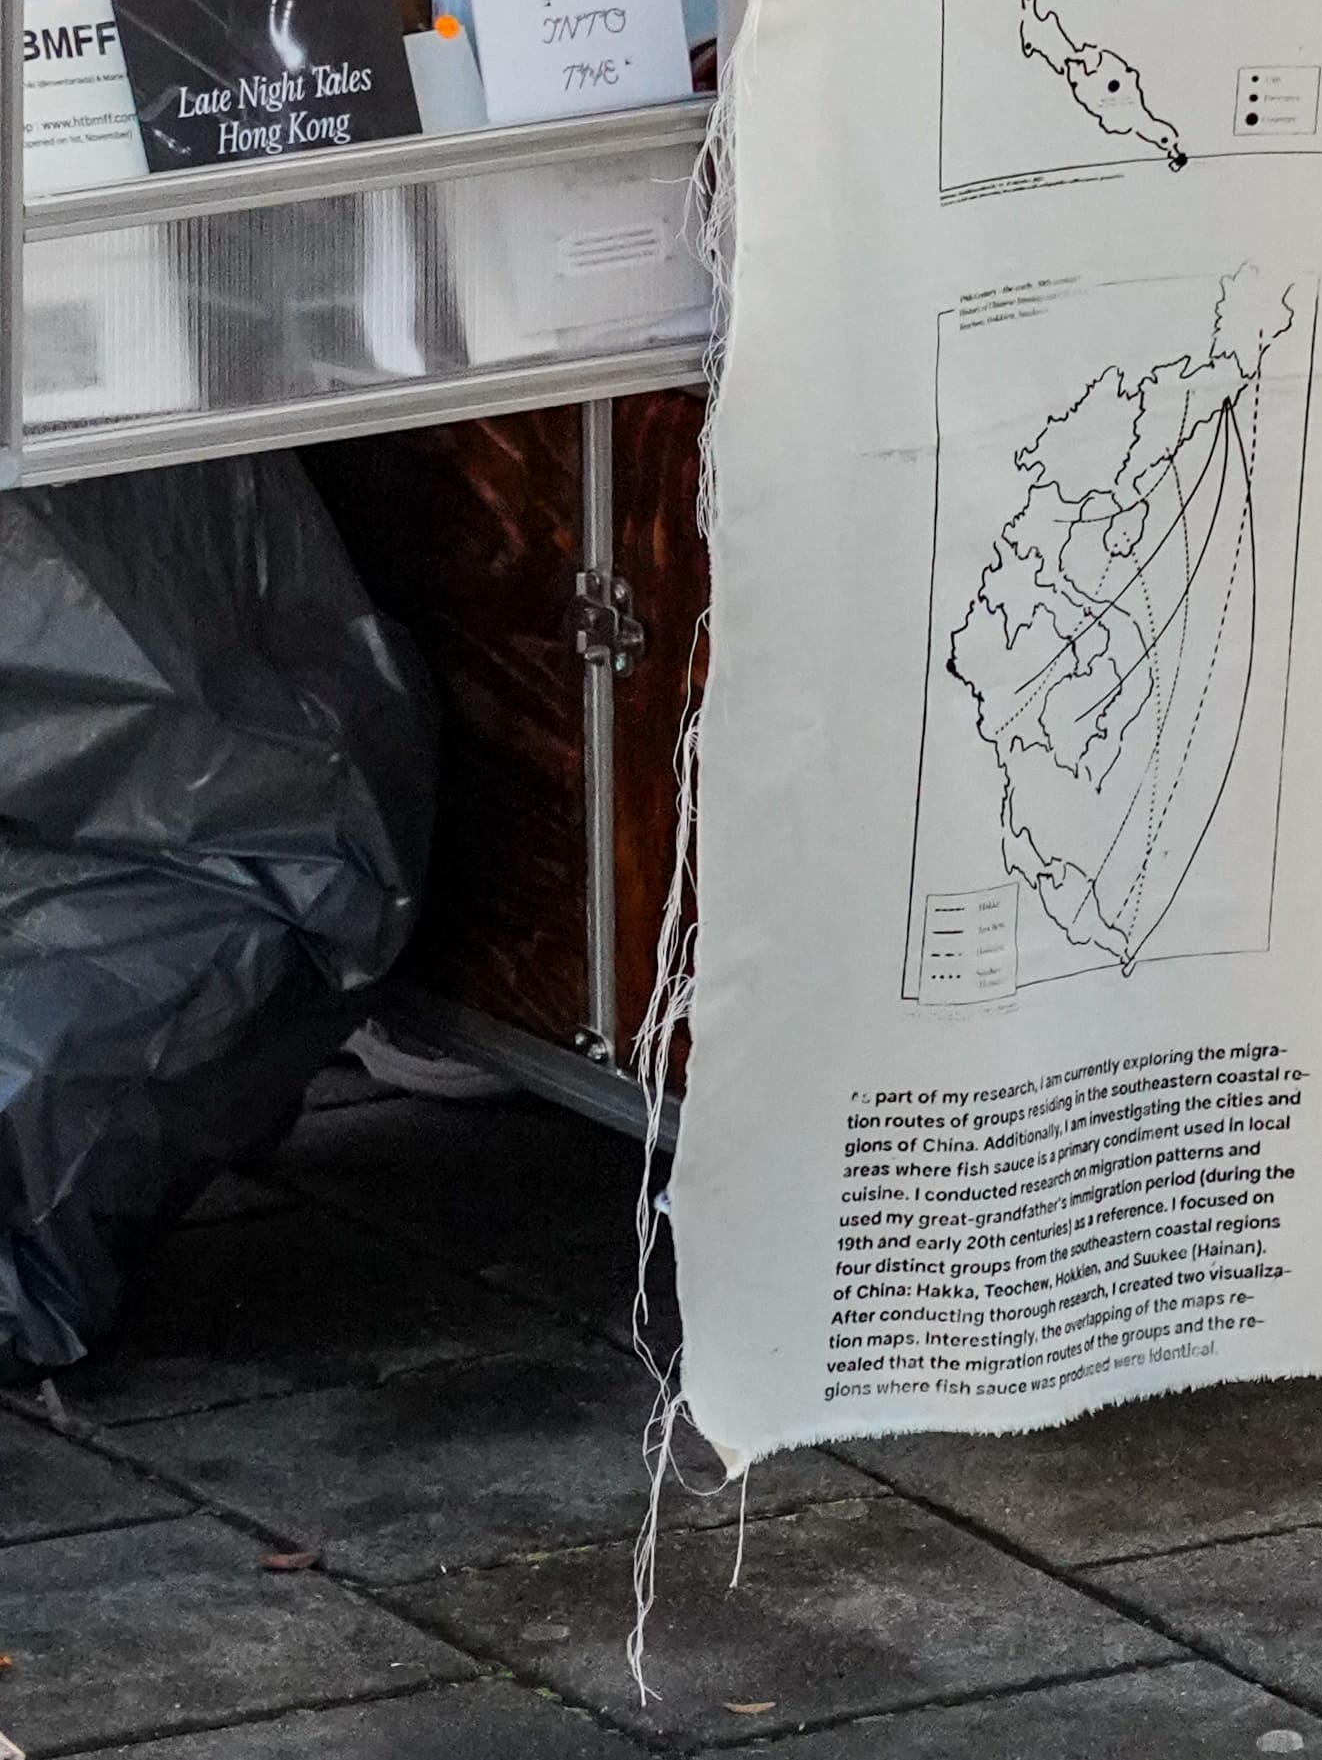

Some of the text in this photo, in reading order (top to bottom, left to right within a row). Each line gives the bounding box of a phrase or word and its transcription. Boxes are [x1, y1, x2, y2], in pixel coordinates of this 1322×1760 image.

[179, 62, 372, 118] Late Night Tales
[218, 110, 351, 155] Hong Kong
[847, 1066, 1310, 1132] tion routes of groups residing in the southeastern coastal re-
[833, 1238, 1266, 1302] of China: Hakka, Teochew, Hokkien, and Suukee (Hainan).
